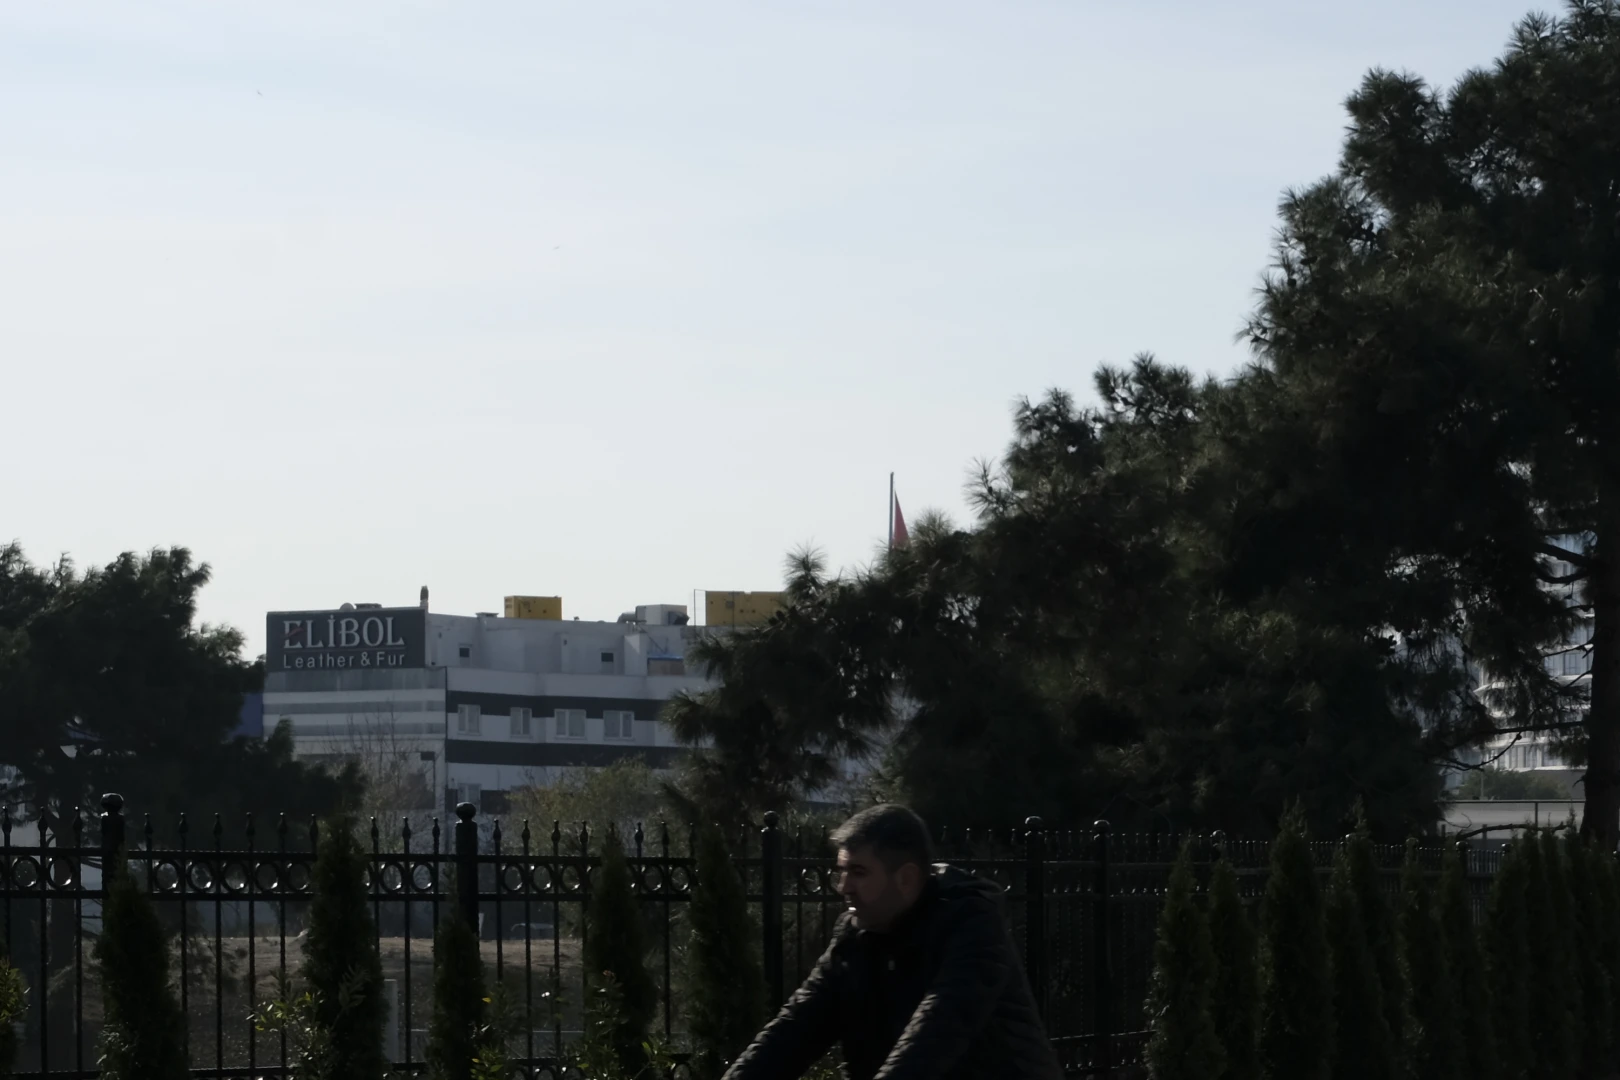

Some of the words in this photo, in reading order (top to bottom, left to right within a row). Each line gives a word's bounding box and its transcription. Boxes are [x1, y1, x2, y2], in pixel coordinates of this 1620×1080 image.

[283, 614, 405, 649] ELİBOL
[283, 653, 354, 669] Leather
[360, 651, 371, 667] &
[376, 651, 405, 666] Fur
